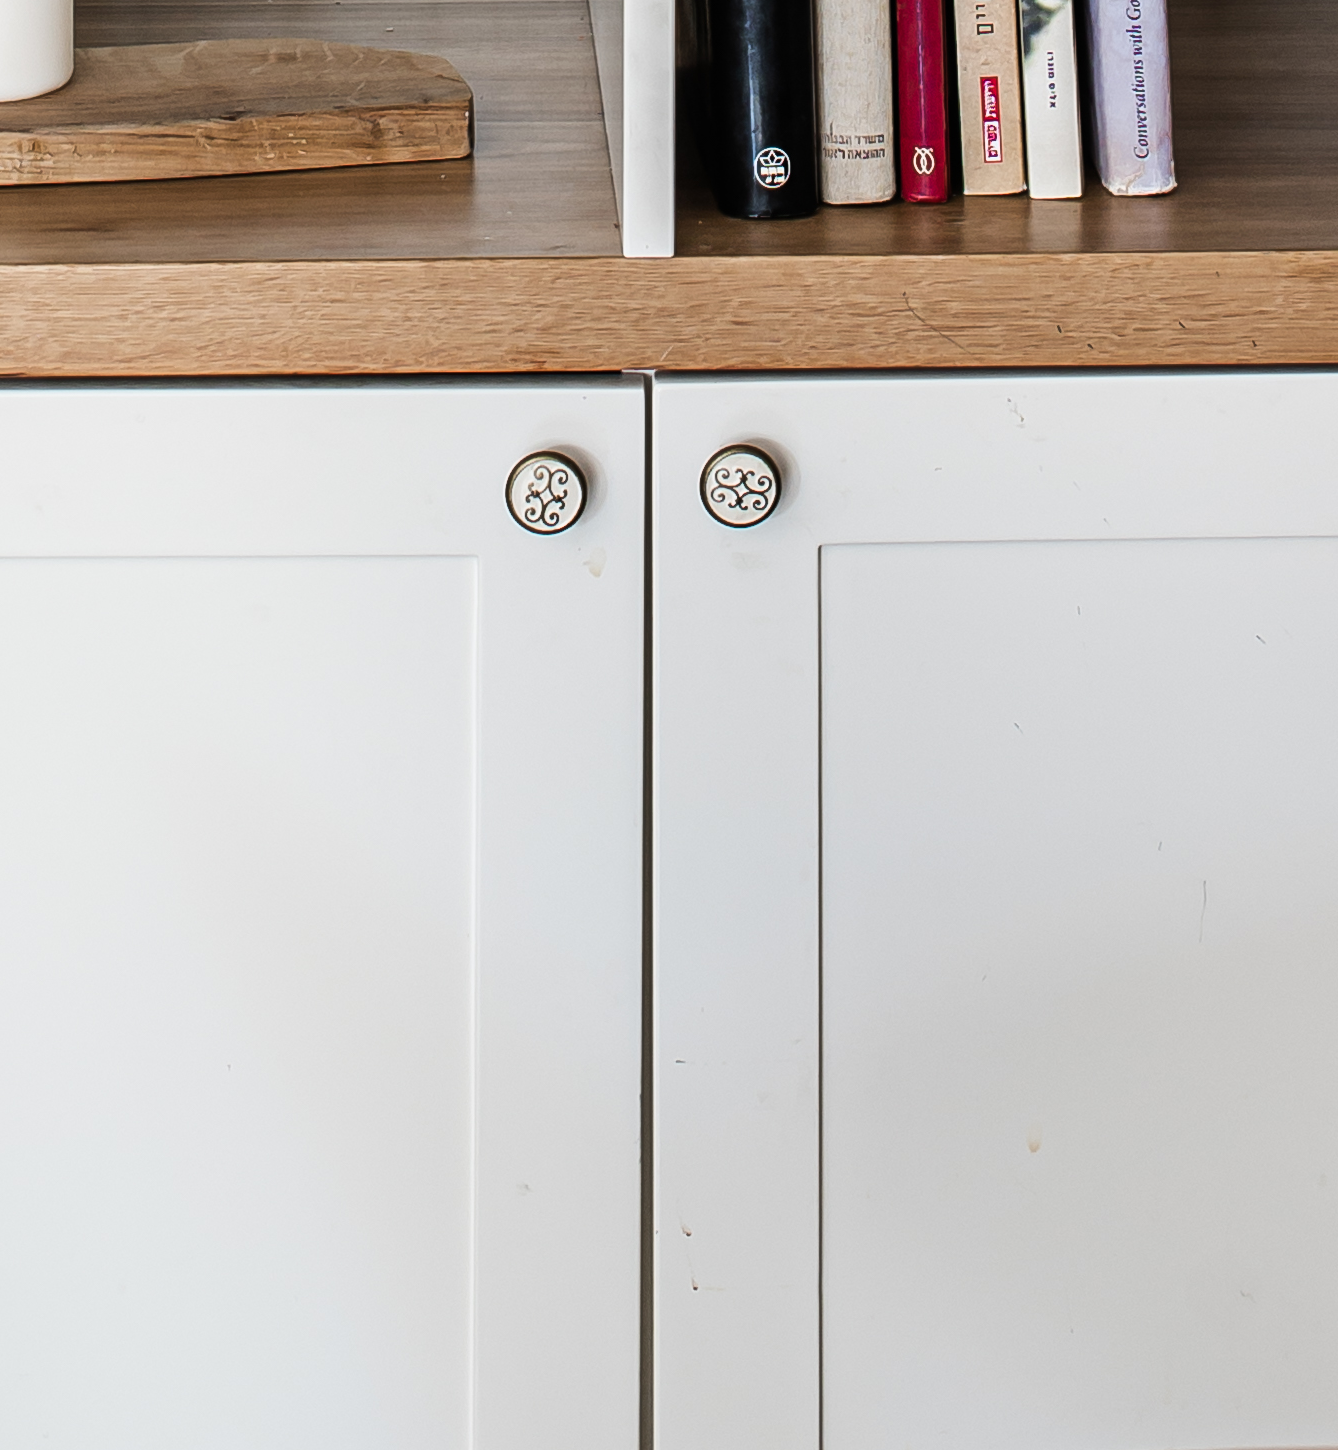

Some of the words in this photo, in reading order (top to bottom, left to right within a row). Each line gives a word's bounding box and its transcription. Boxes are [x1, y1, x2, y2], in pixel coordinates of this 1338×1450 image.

[1125, 25, 1143, 55] with
[1046, 51, 1056, 79] מונרו
[1048, 82, 1057, 108] אליס
[1131, 59, 1149, 159] Conversations
